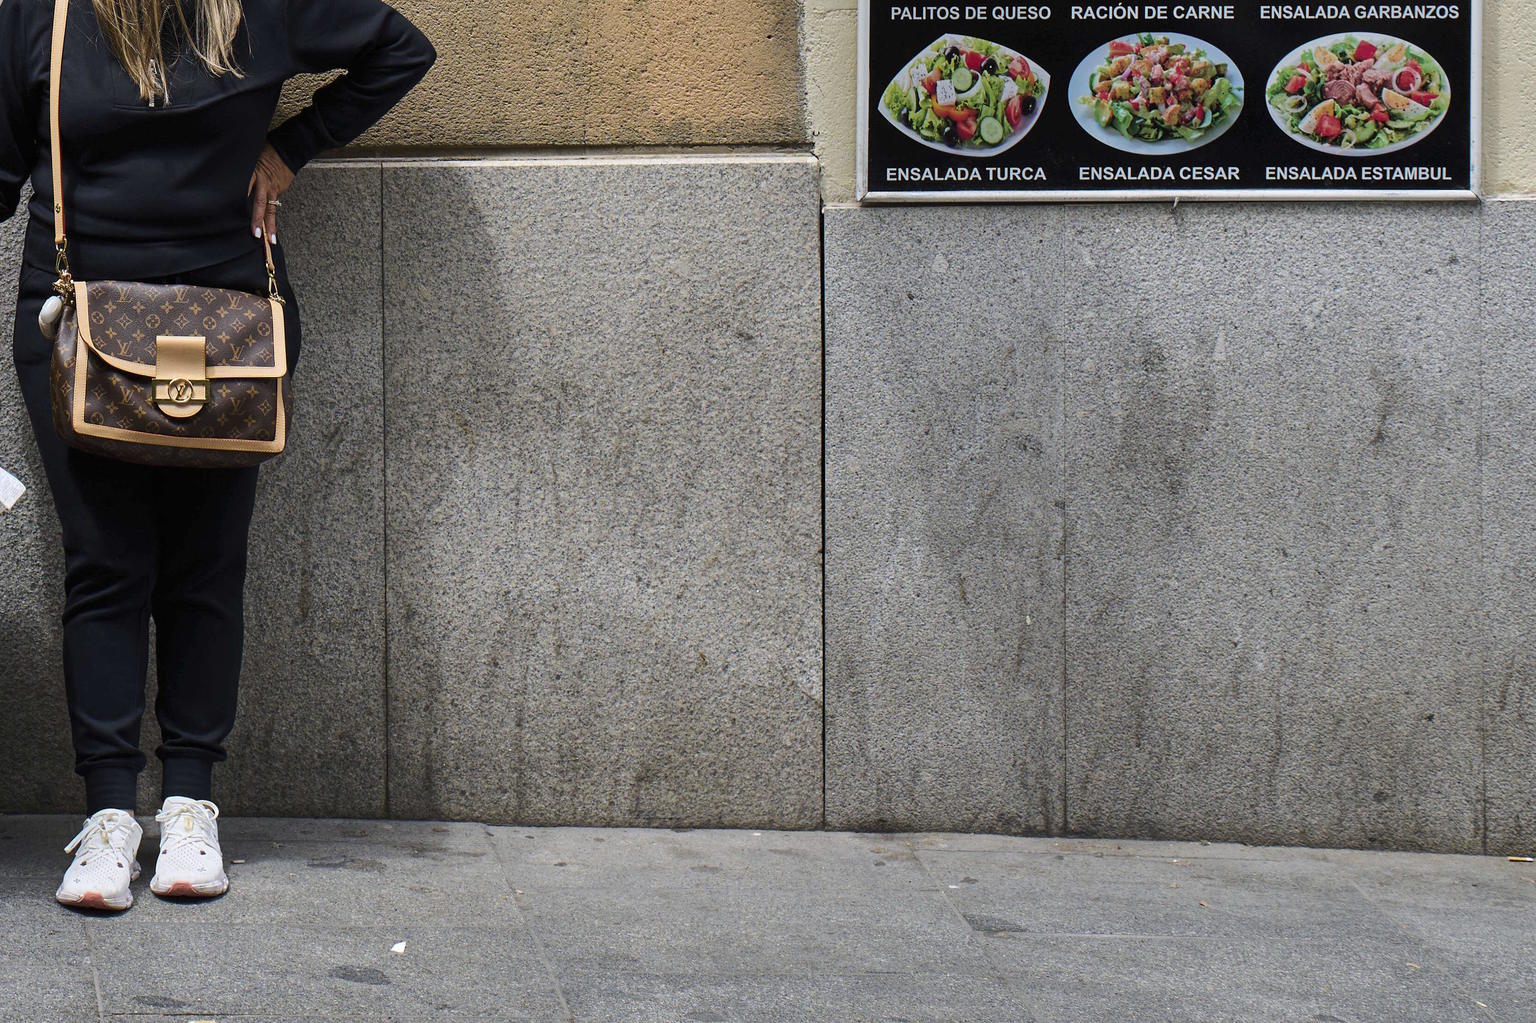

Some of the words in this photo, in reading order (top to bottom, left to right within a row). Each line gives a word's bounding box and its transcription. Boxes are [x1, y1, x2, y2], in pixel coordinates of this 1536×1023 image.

[891, 6, 960, 20] PALITOS
[965, 6, 988, 20] DE
[991, 5, 1052, 21] QUESO
[1071, 2, 1139, 20] RACIÓN
[1144, 5, 1168, 20] DE
[1172, 5, 1235, 20] CARNE
[1260, 5, 1351, 20] ENSALADA
[1354, 4, 1460, 20] GARBANZOS
[886, 167, 982, 182] ENSALADA
[985, 166, 1047, 181] TURCA
[1079, 166, 1176, 181] ENSALADA
[1179, 166, 1240, 181] CESAR
[1265, 166, 1358, 181] ENSALADA
[1361, 166, 1453, 181] ESTAMBUL
